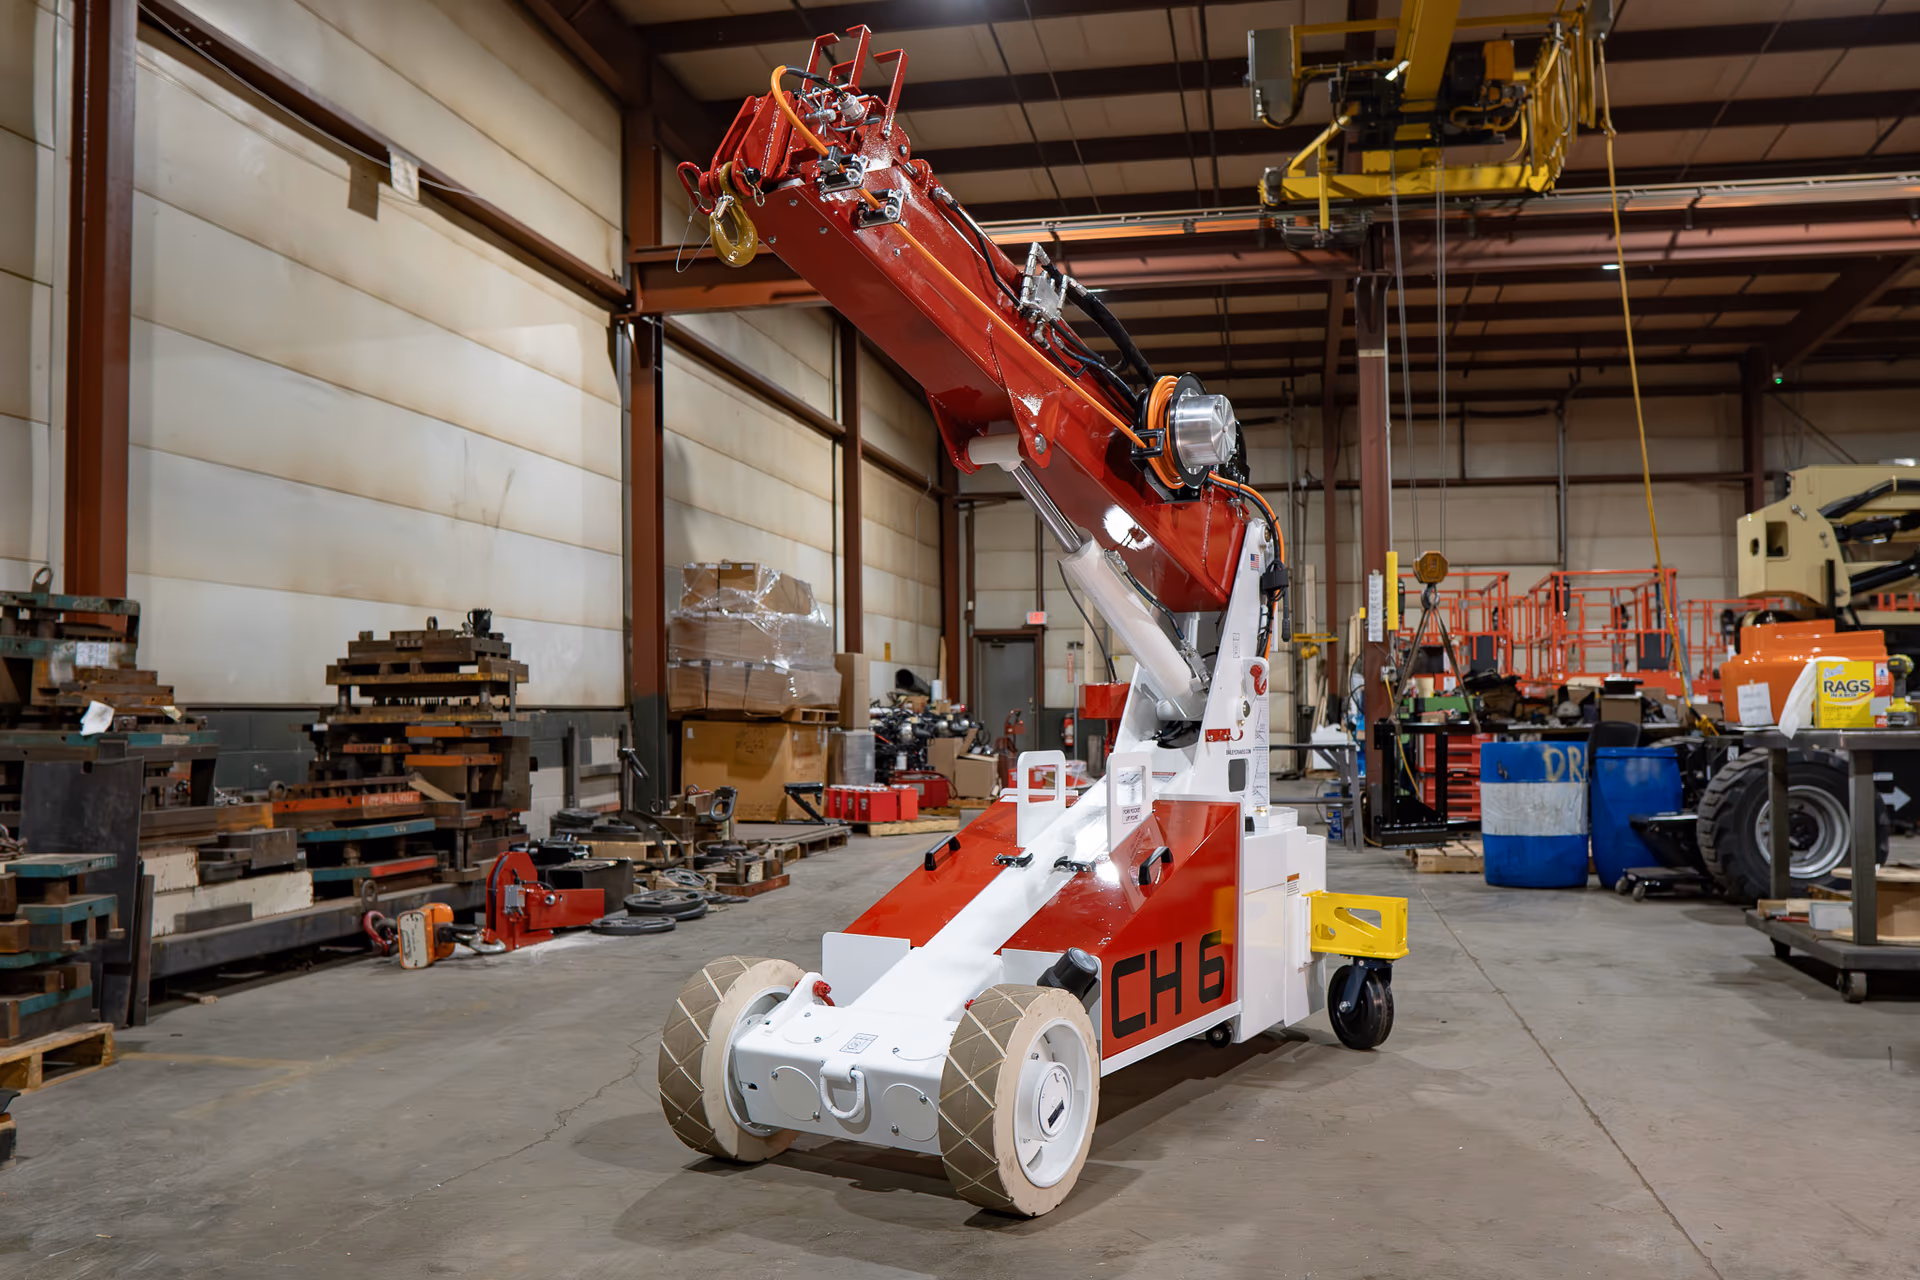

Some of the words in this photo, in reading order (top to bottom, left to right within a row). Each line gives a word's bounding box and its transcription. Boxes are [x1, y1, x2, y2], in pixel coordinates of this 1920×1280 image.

[1823, 680, 1871, 693] RAGS
[1111, 941, 1182, 1039] CH
[1199, 929, 1225, 1004] 6
